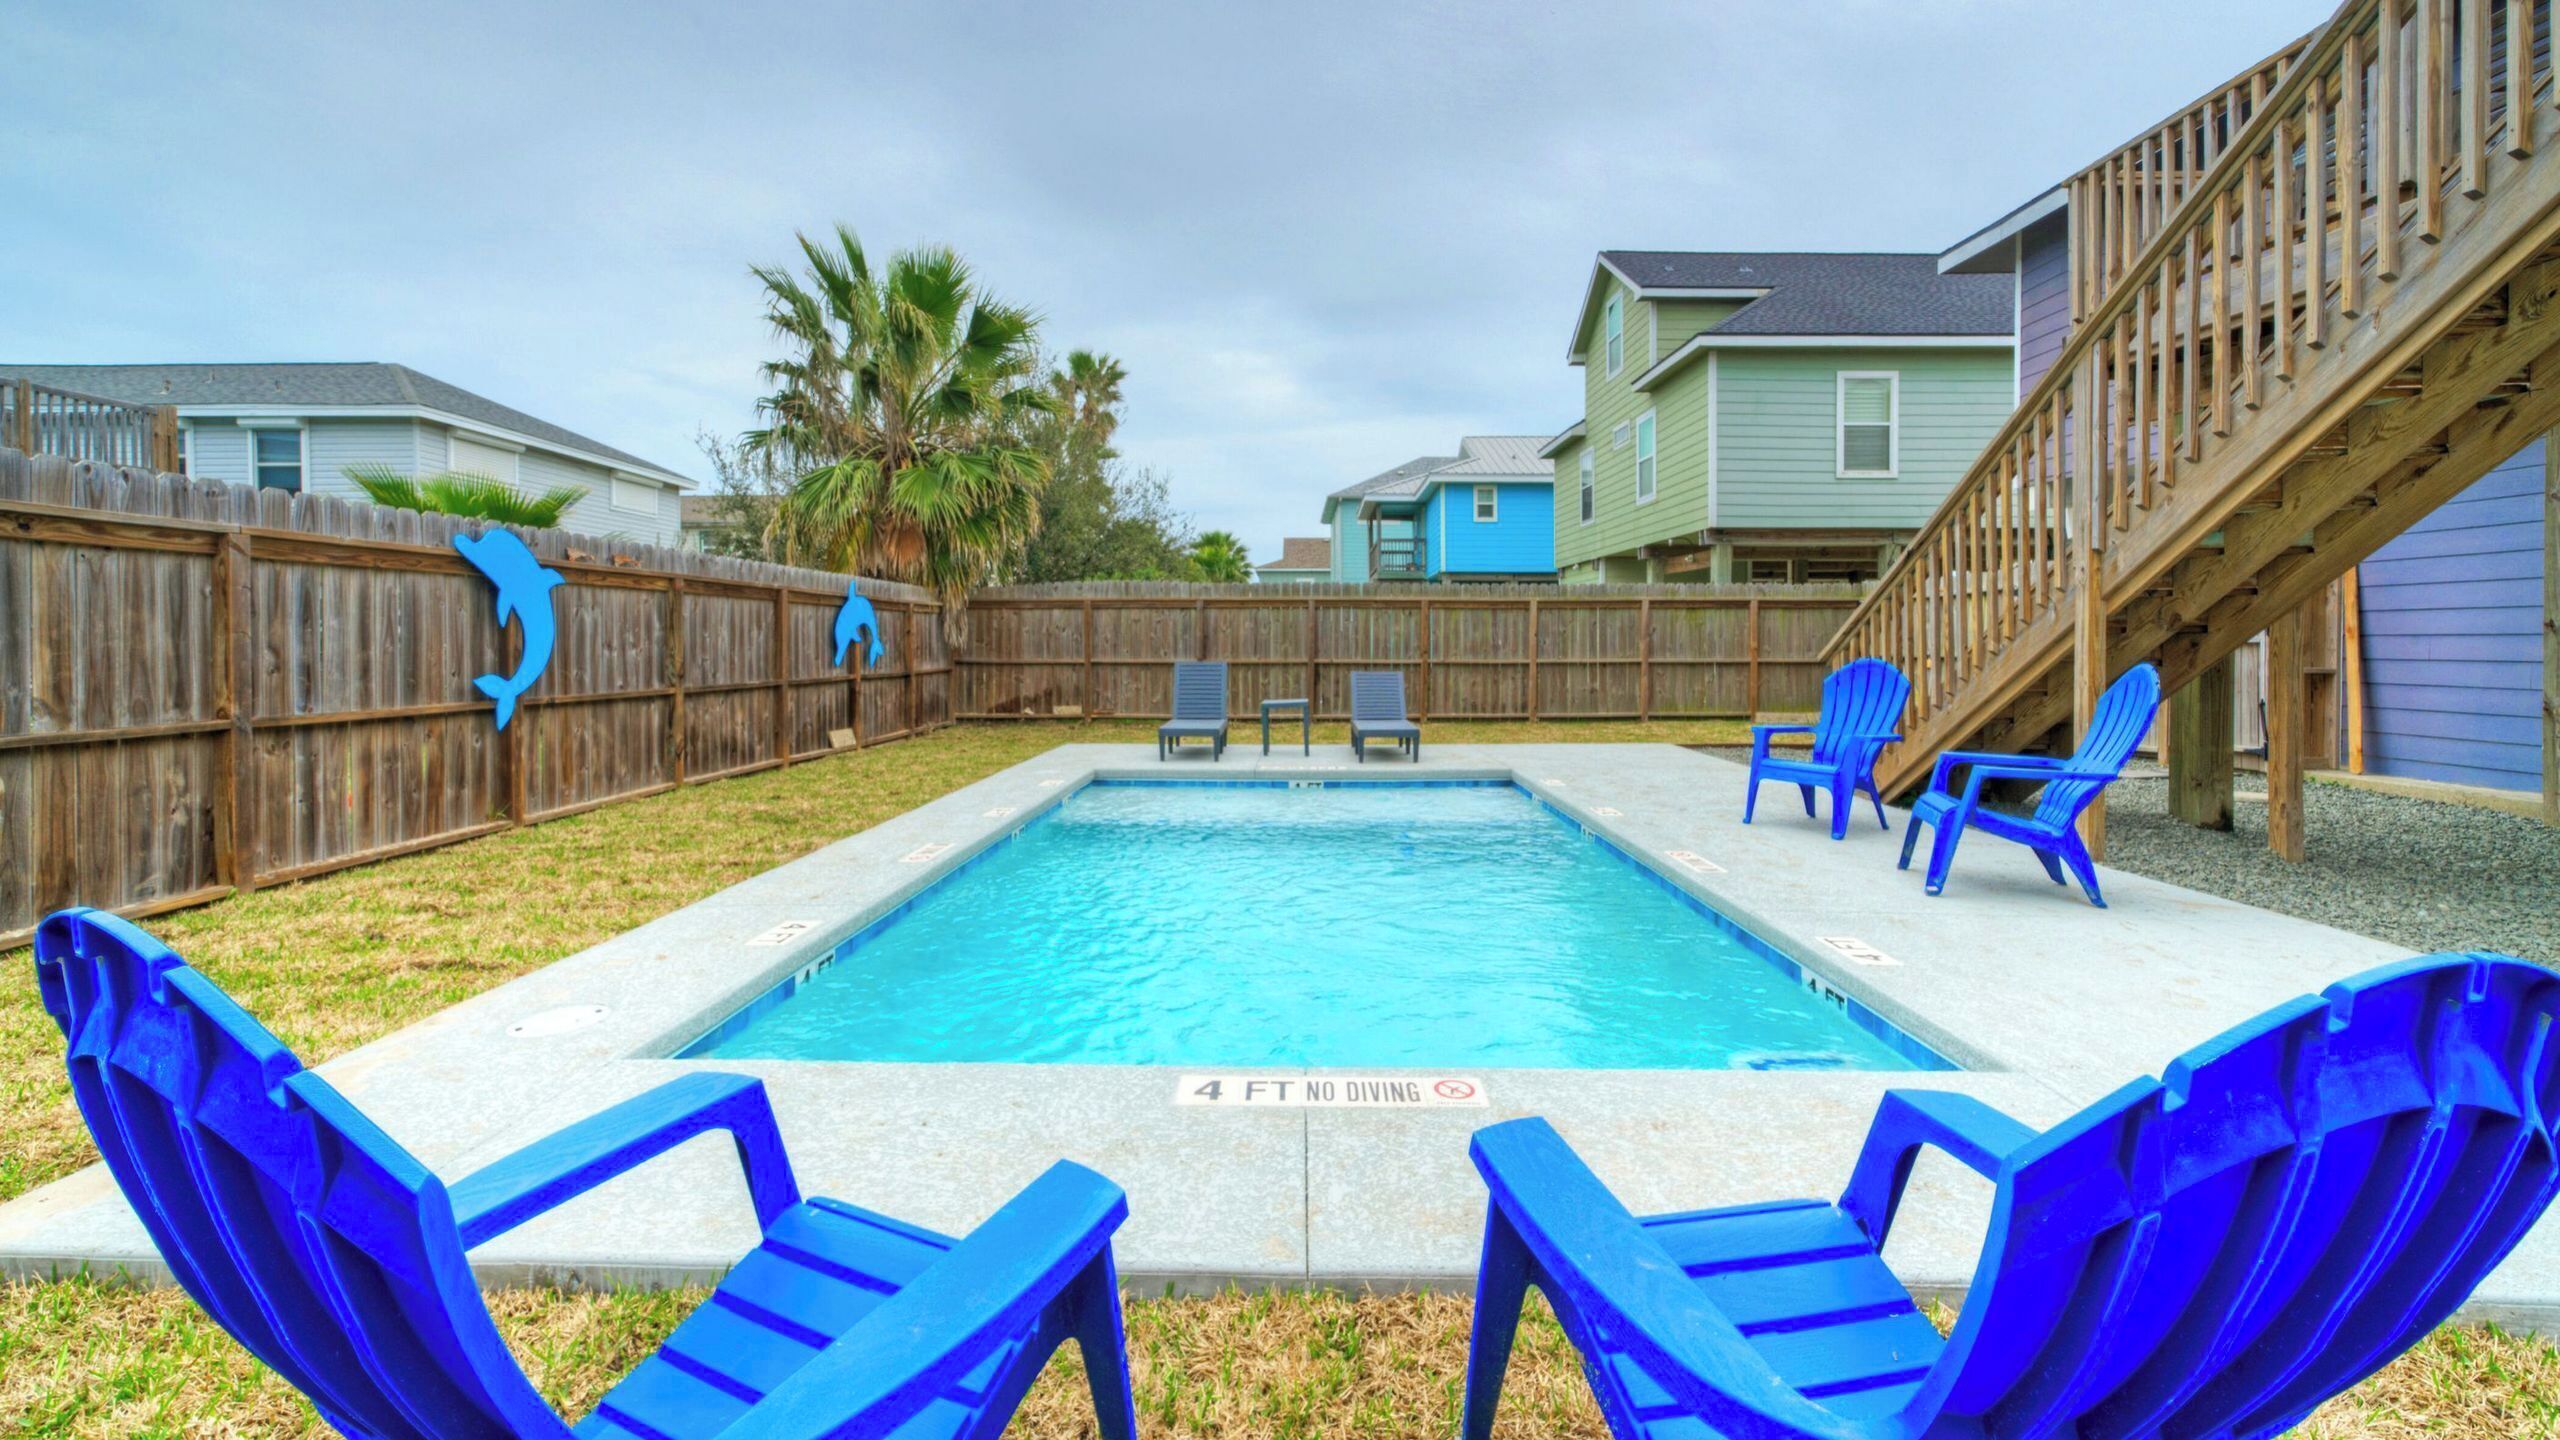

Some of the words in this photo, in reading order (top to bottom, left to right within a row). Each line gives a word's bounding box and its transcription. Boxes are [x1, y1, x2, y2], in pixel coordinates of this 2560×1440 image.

[817, 953, 834, 976] FT
[1807, 977, 1818, 994] 4
[1825, 986, 1846, 1010] FT
[1193, 1079, 1223, 1101] 4
[1245, 1080, 1295, 1102] FT
[1306, 1080, 1335, 1102] NO
[1346, 1081, 1421, 1103] DIVING
